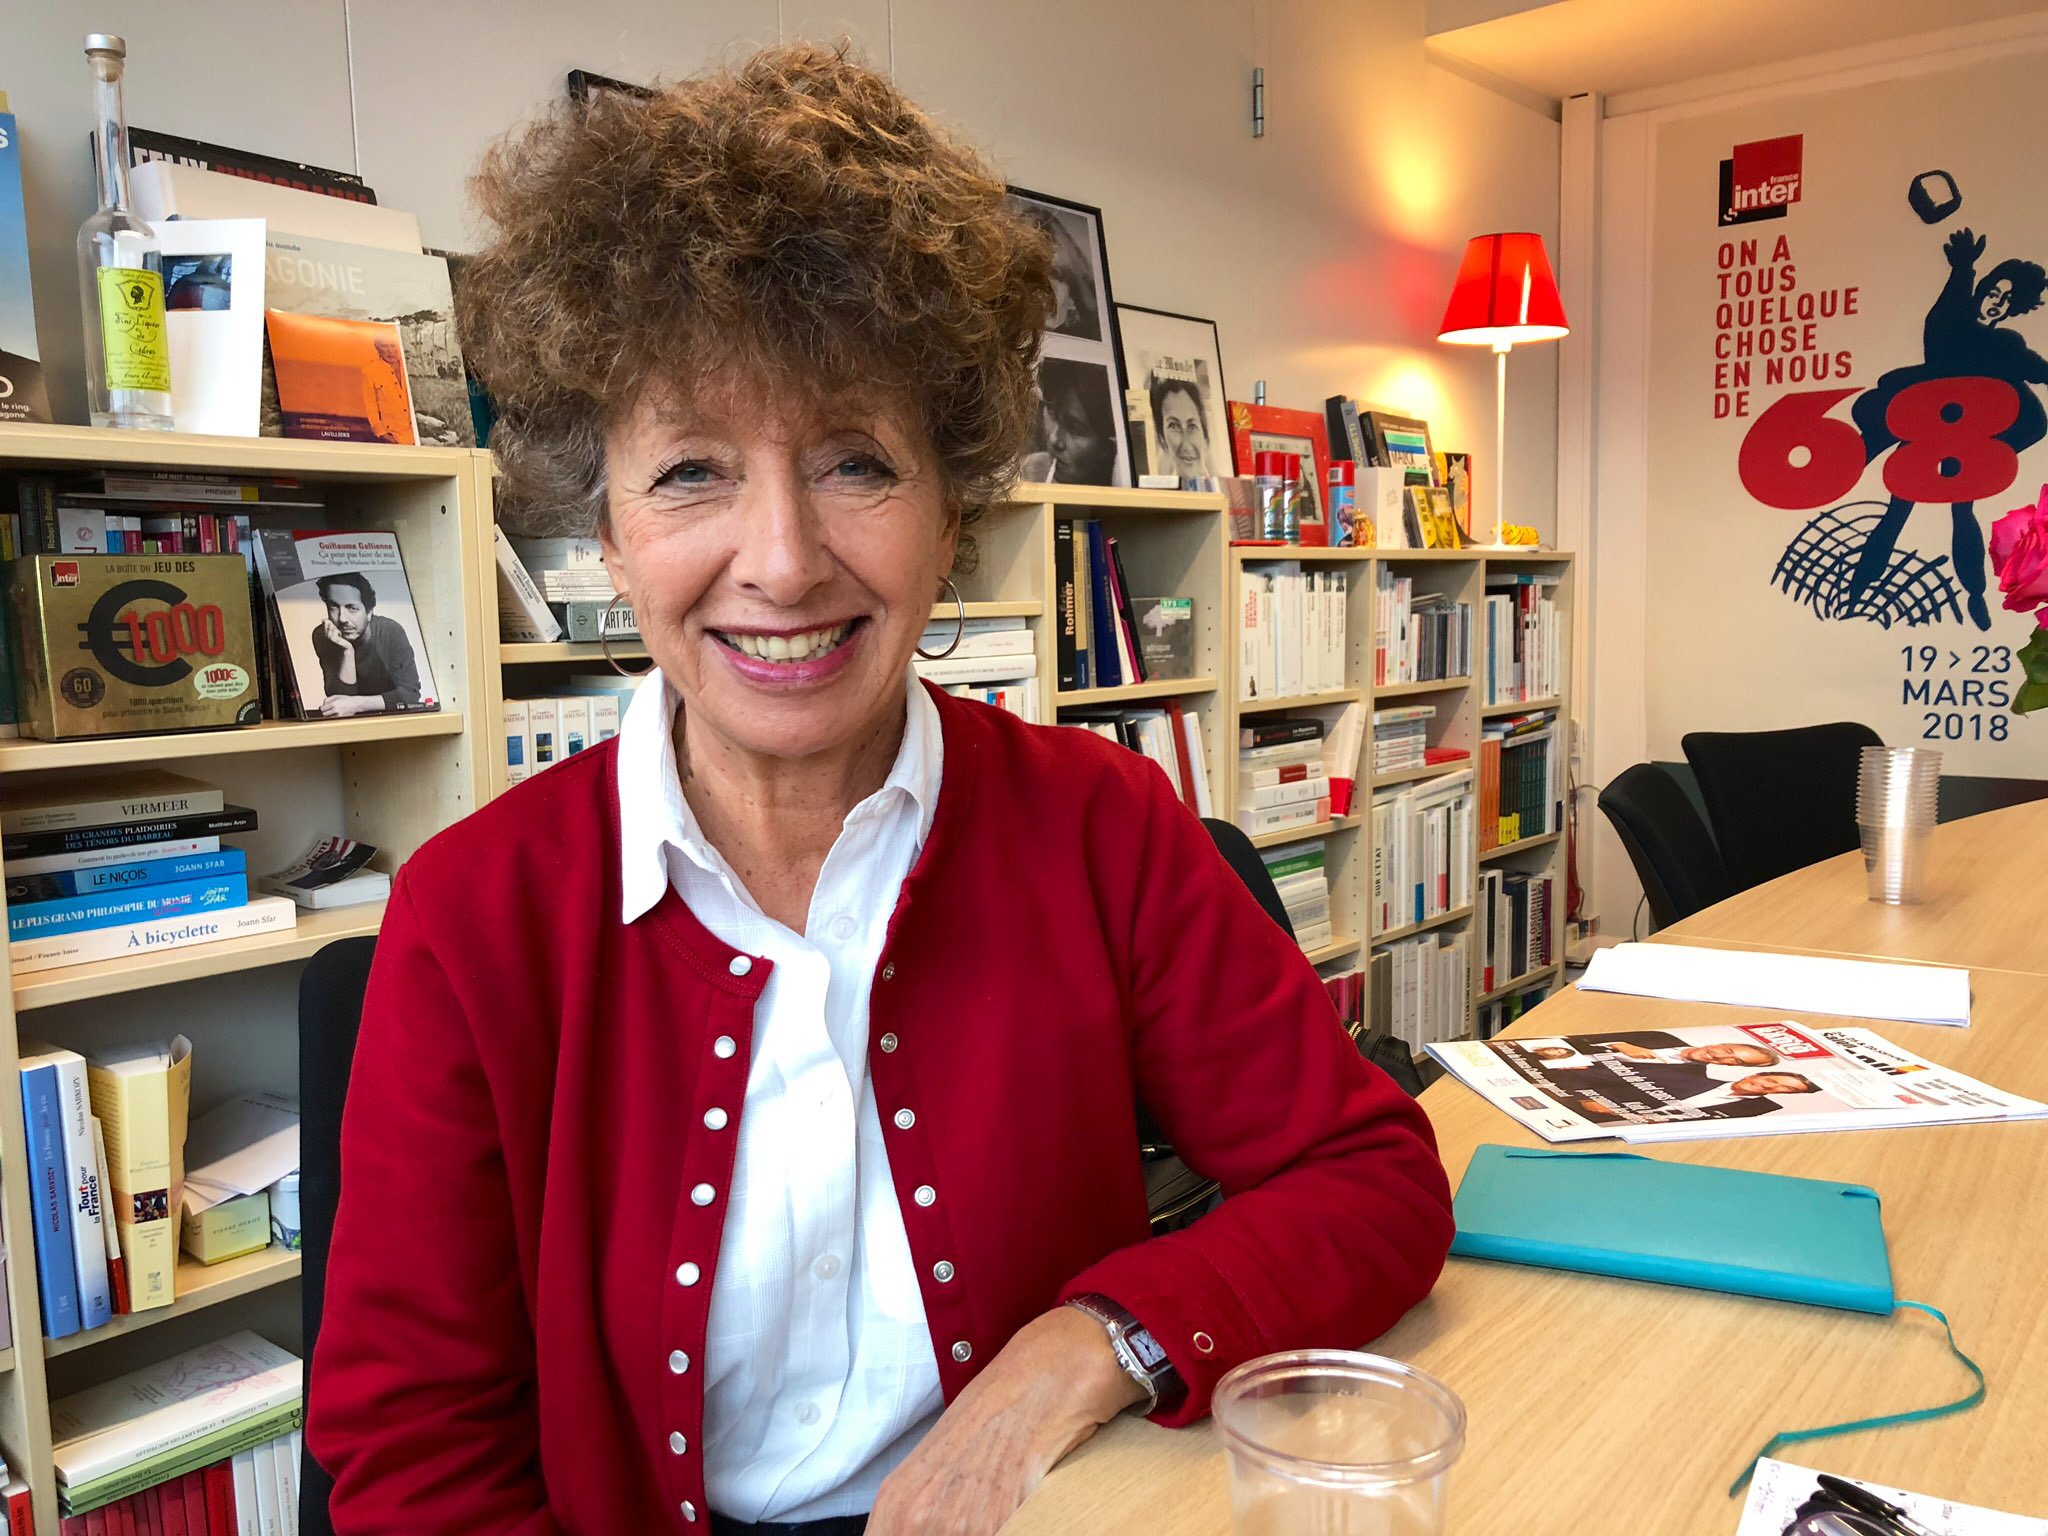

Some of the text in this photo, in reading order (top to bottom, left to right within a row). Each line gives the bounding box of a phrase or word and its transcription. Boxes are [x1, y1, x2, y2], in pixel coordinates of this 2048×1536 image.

[1770, 173, 1799, 184] france
[1734, 180, 1799, 210] inter
[1718, 234, 1791, 270] ON A
[1717, 264, 1796, 300] TOUS
[1716, 286, 1859, 331] QUELQUE
[1715, 323, 1817, 360] CHOSE
[1163, 356, 1193, 372] Monde
[1714, 350, 1853, 390] EN NOUS
[1714, 390, 1750, 419] DE
[321, 430, 350, 438] LAVILLIERS
[1738, 375, 2021, 510] 68
[47, 523, 57, 549] Robert
[318, 542, 357, 550] Guillaume
[105, 564, 115, 574] LA
[153, 561, 172, 573] JEU
[175, 561, 195, 573] DES
[1065, 581, 1075, 635] Rohmer
[121, 602, 225, 664] 1000
[1901, 646, 1937, 673] 19
[1971, 645, 2011, 673] 23
[74, 677, 92, 693] 60
[1902, 678, 2010, 707] MARS
[1922, 713, 2008, 741] 2018
[121, 799, 189, 816] VERMEER
[65, 822, 178, 841] LES GRANDES PLAIDOIRIES
[209, 821, 233, 829] Matthieu
[66, 841, 83, 850] DES
[121, 835, 135, 844] DU
[136, 832, 174, 843] BARREAU
[93, 869, 147, 886] LE NIÇOIS
[175, 859, 225, 873] JOANN SFAR
[12, 917, 27, 931] LE
[27, 914, 51, 928] PLUS
[50, 908, 84, 923] GRAND
[86, 901, 145, 919] PHILOSOPHE
[147, 899, 161, 911] DU
[237, 914, 277, 928] Joann Sfar
[127, 922, 219, 948] À bicyclette
[38, 950, 62, 960] France
[73, 1076, 87, 1137] Nicolas SARKOZY
[47, 1166, 58, 1201] SARKOZY
[78, 1166, 89, 1213] Tout pour
[88, 1175, 101, 1224] la France
[50, 1201, 61, 1233] NICOLAS
[212, 1224, 236, 1235] PIERRE
